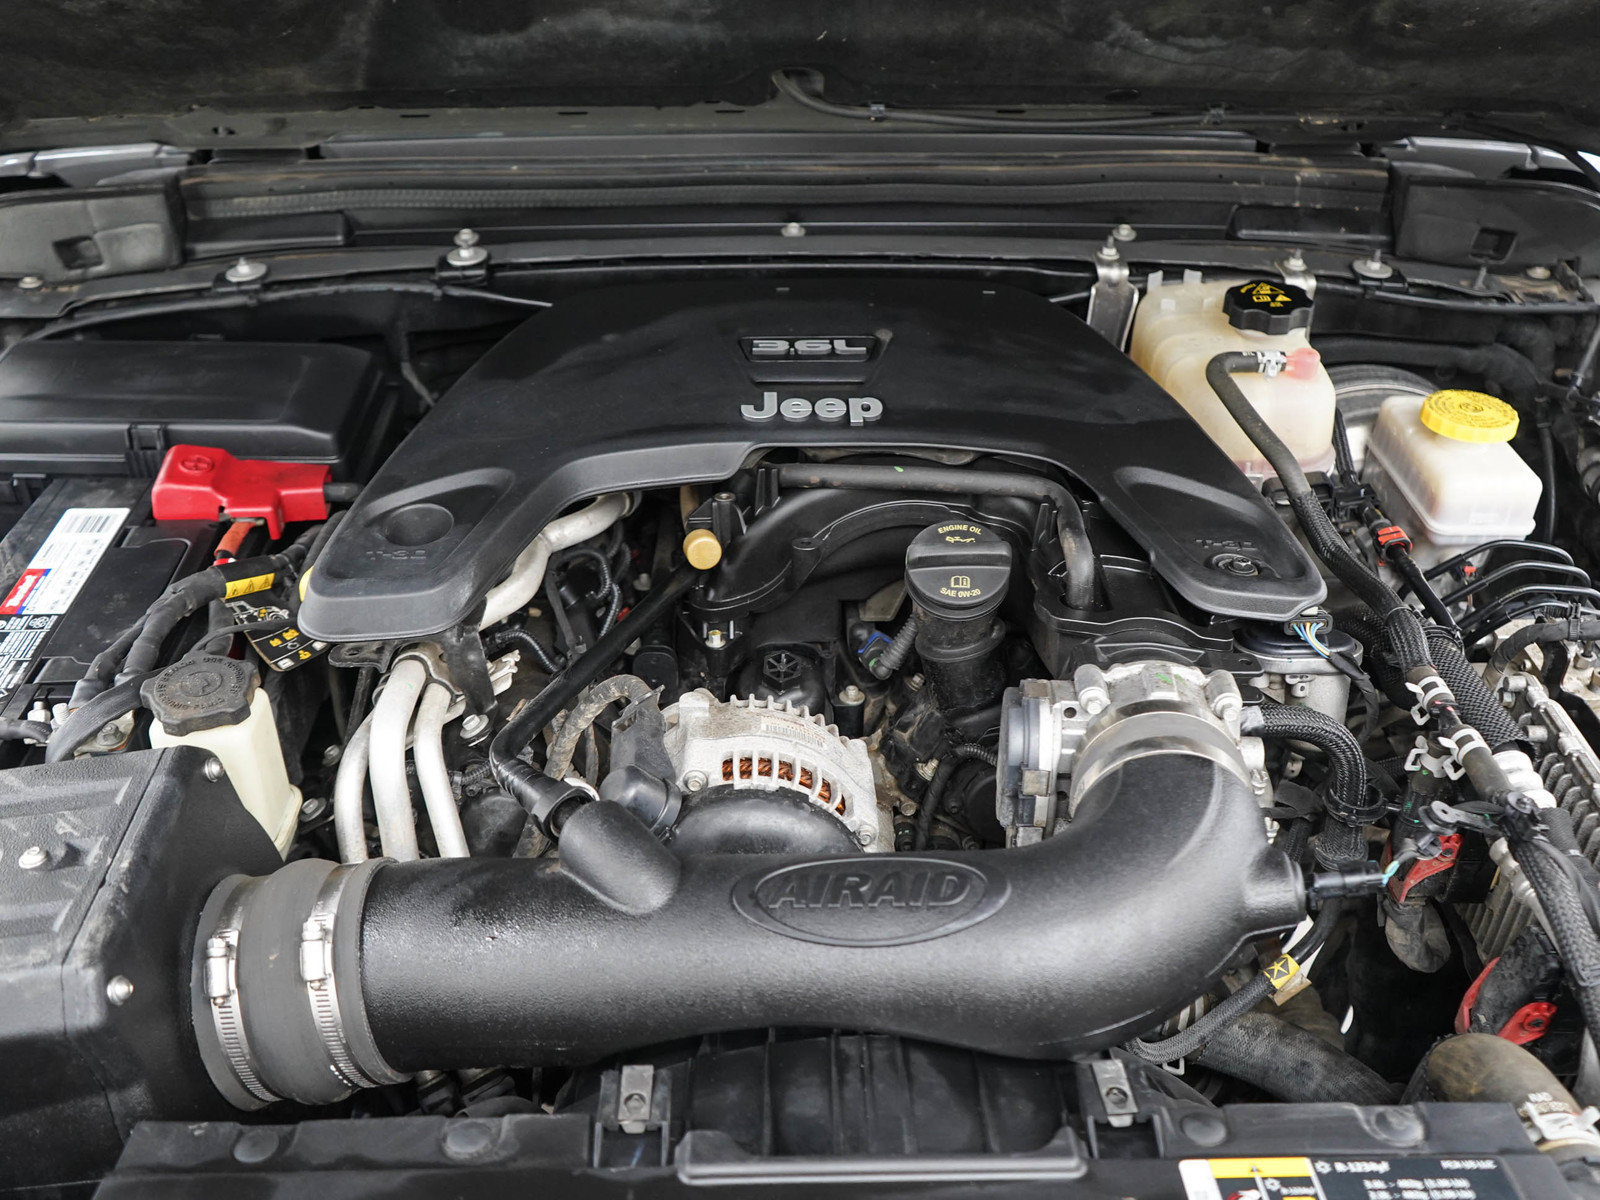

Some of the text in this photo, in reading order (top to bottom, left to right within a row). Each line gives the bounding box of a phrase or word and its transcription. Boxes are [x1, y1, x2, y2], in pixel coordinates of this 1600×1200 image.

[752, 339, 867, 356] 3.6L
[740, 391, 884, 426] Jeep
[938, 524, 982, 535] ENGINE OIL
[940, 587, 981, 598] SAE 0W-20
[768, 871, 973, 908] AIRAID
